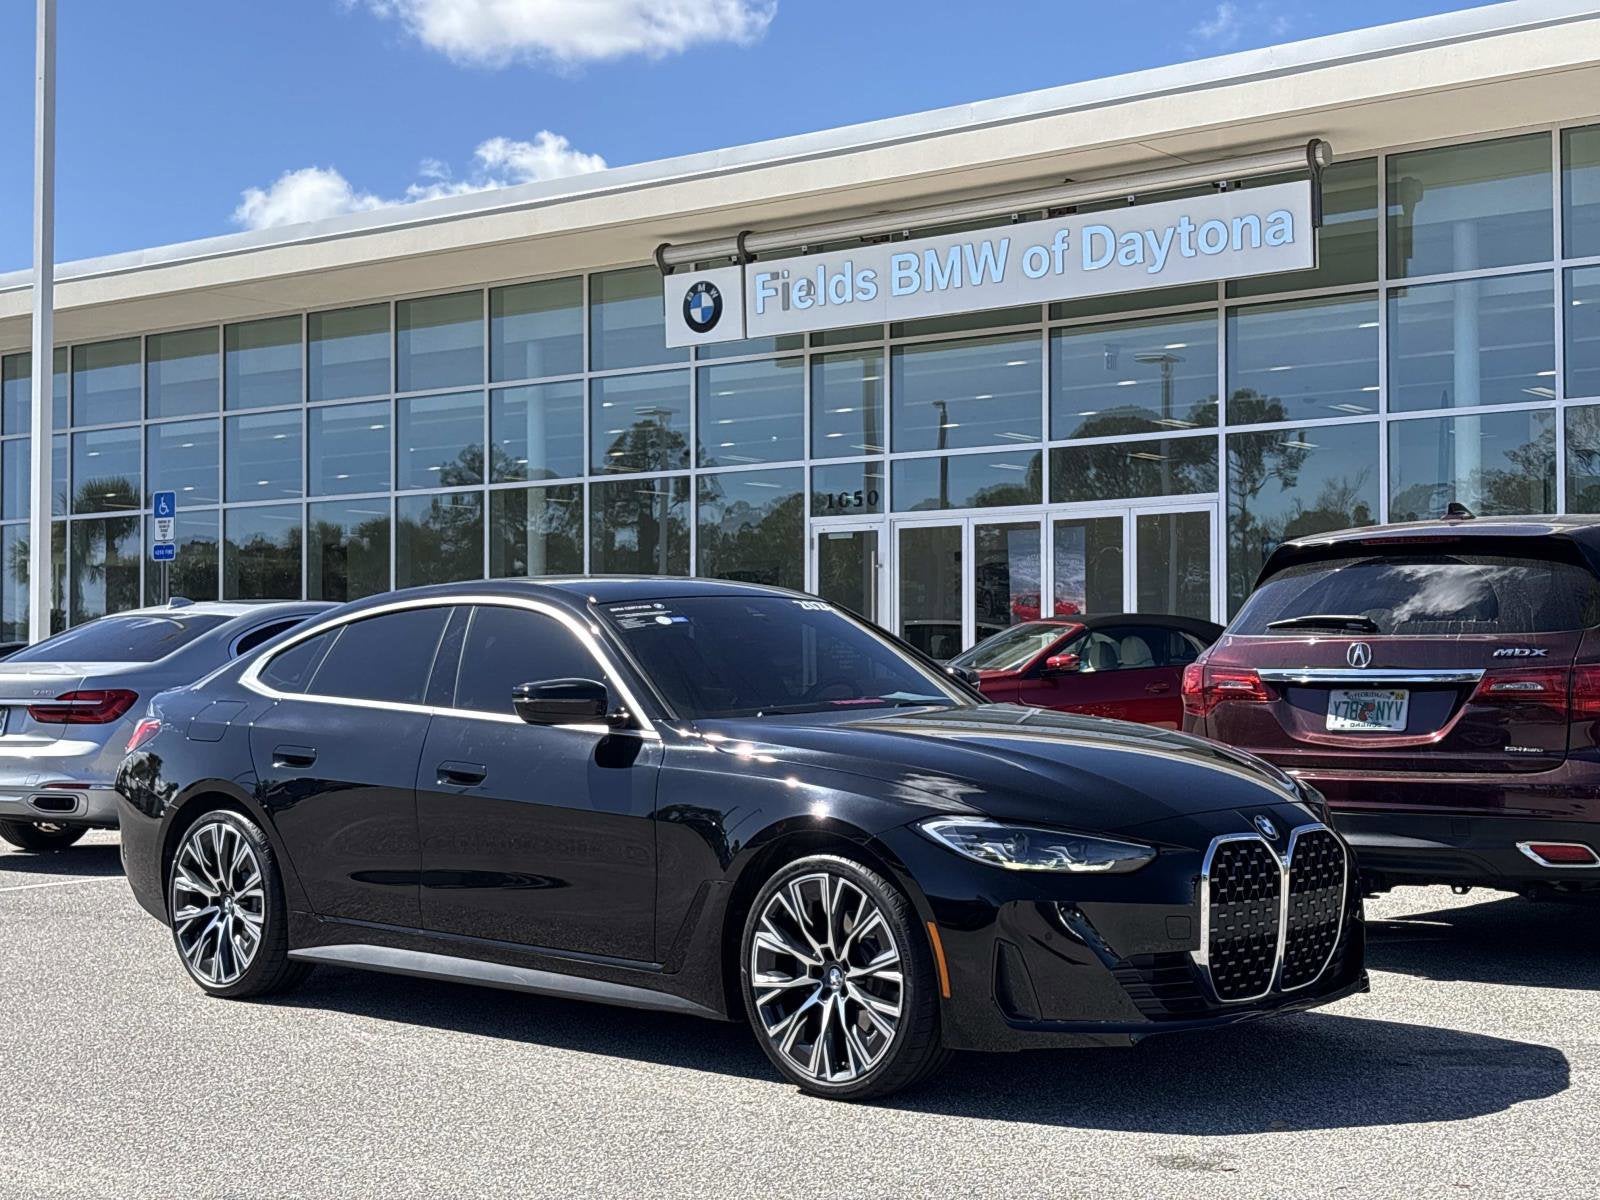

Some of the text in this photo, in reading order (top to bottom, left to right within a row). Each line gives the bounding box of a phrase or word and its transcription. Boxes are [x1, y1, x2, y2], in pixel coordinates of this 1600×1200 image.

[754, 208, 1295, 315] Fields BMW of Daytona
[686, 283, 719, 301] BMW
[1492, 648, 1548, 657] MDX
